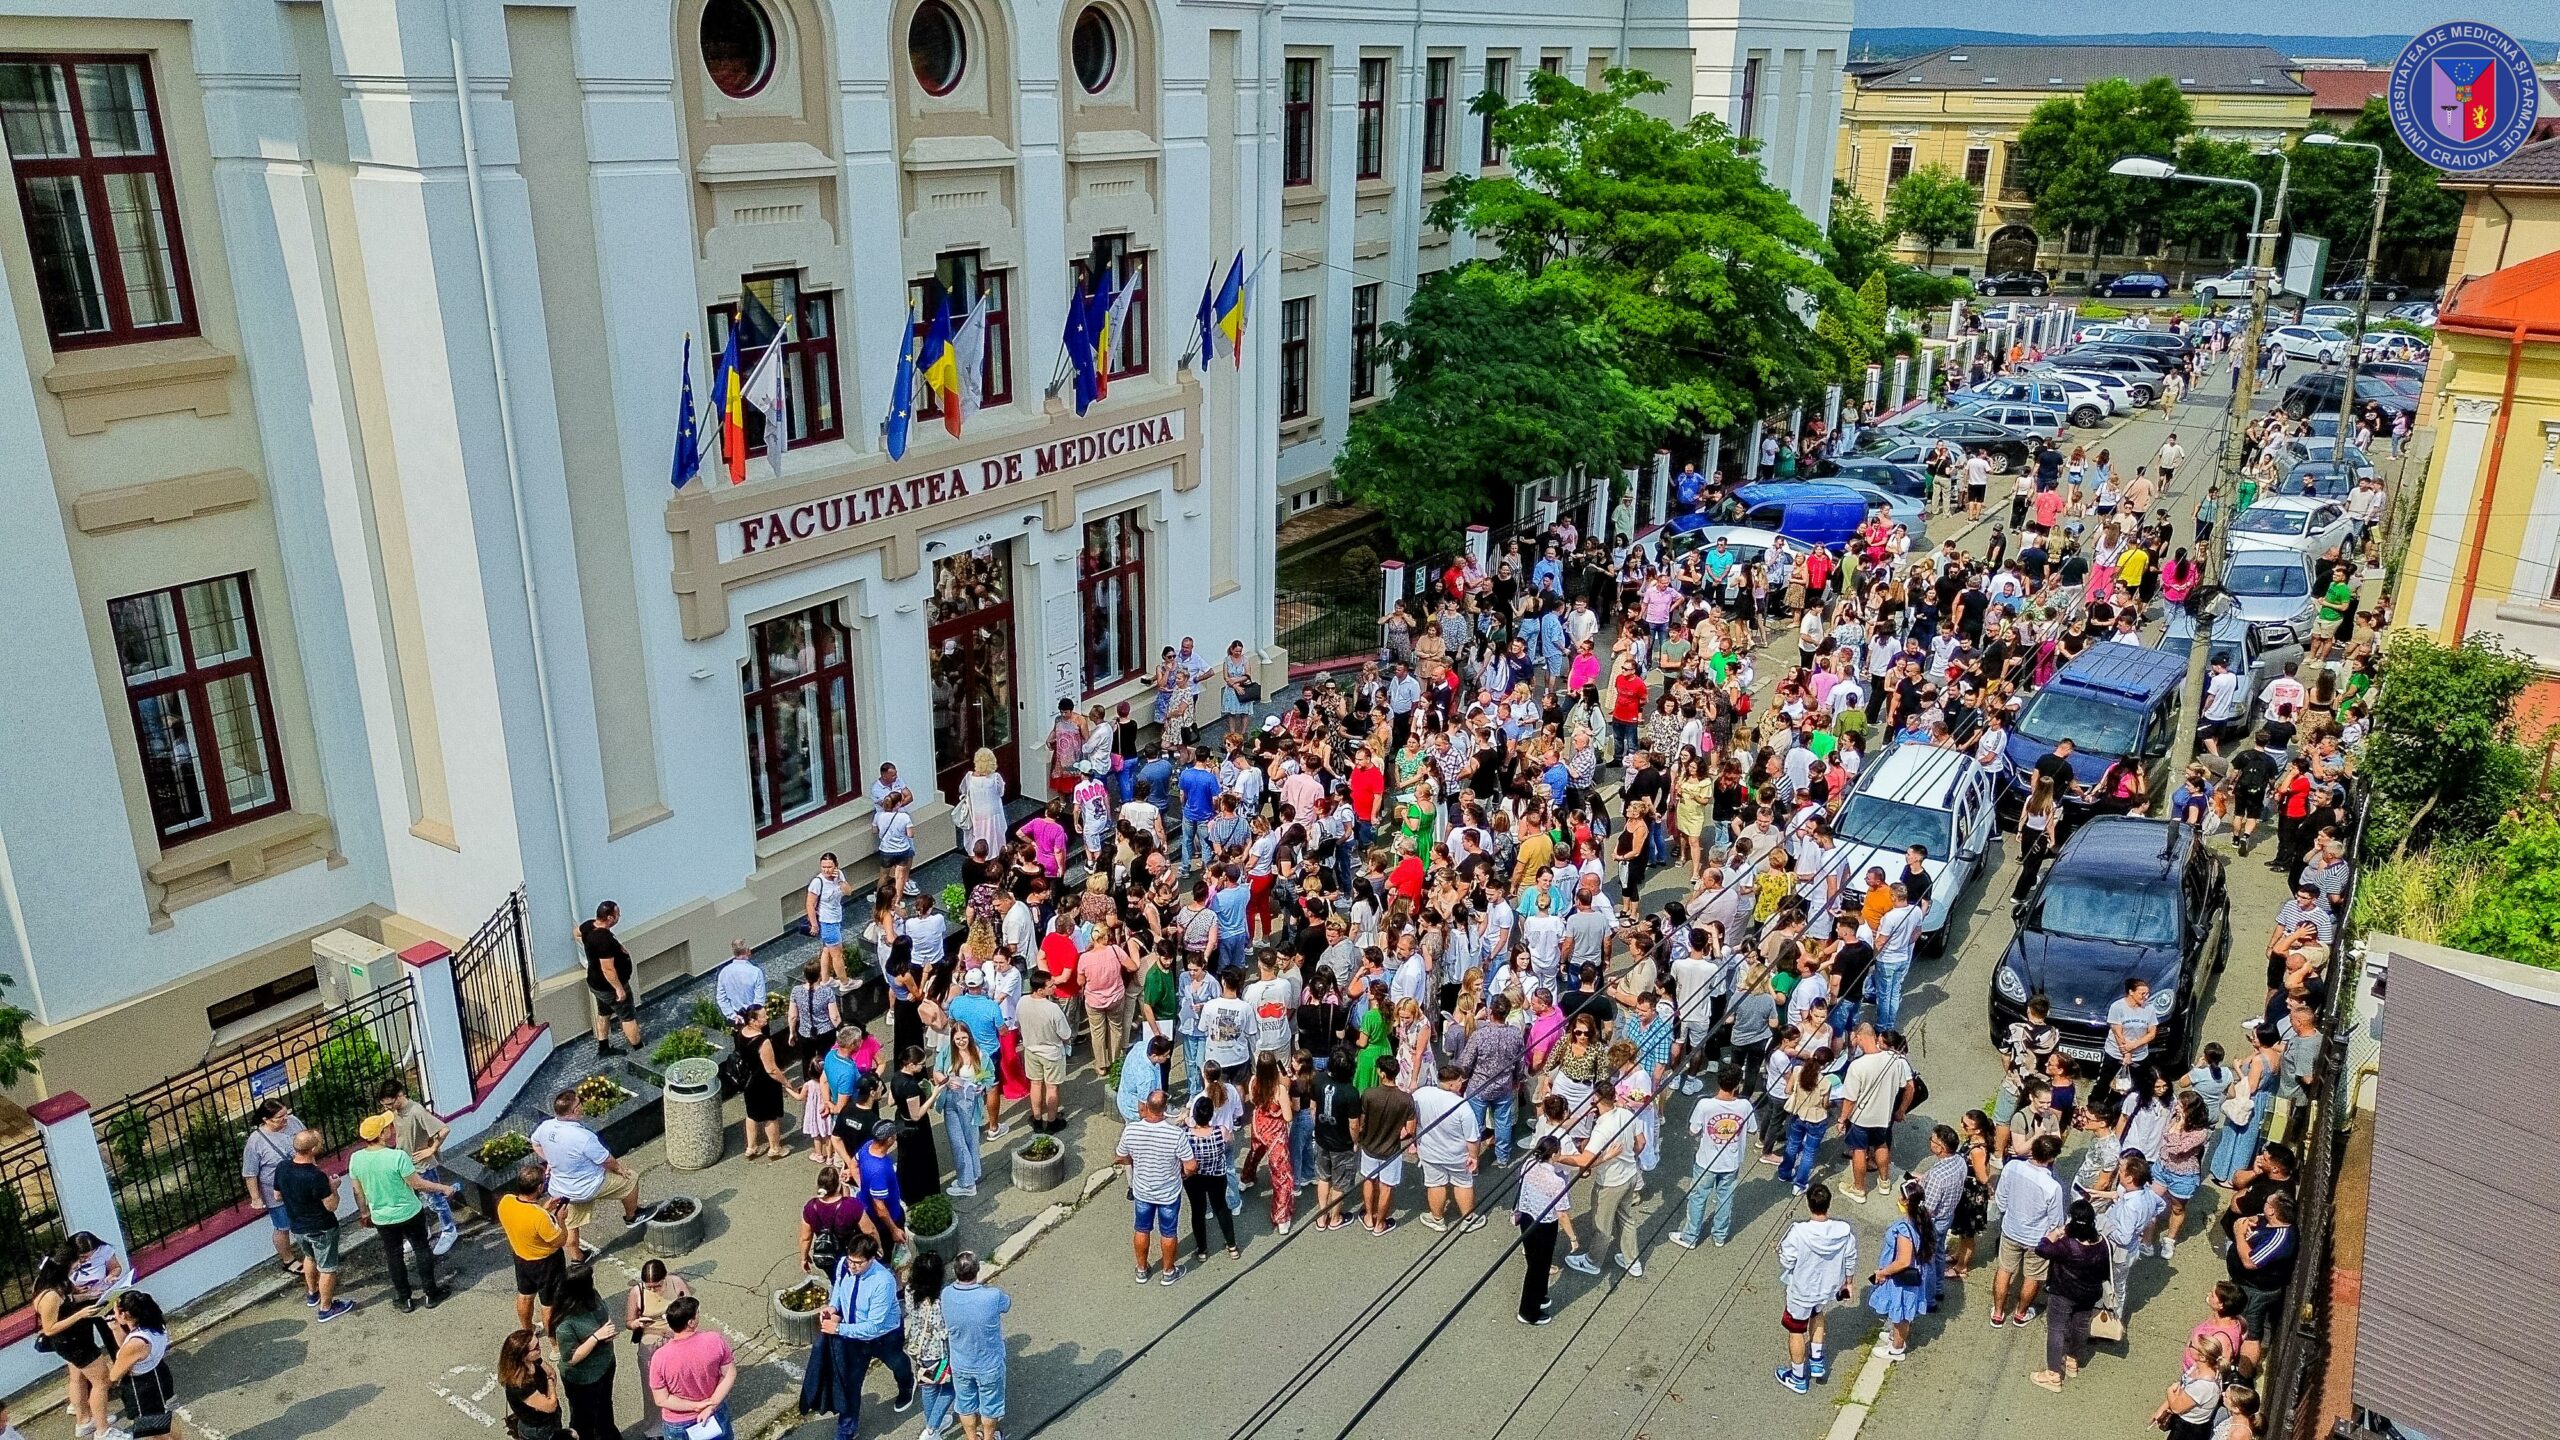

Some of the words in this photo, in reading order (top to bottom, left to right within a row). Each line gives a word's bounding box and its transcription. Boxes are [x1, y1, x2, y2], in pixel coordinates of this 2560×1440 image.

[740, 468, 969, 554] FACULTATEA
[982, 454, 1022, 491] DE
[1035, 416, 1175, 477] MEDICINA
